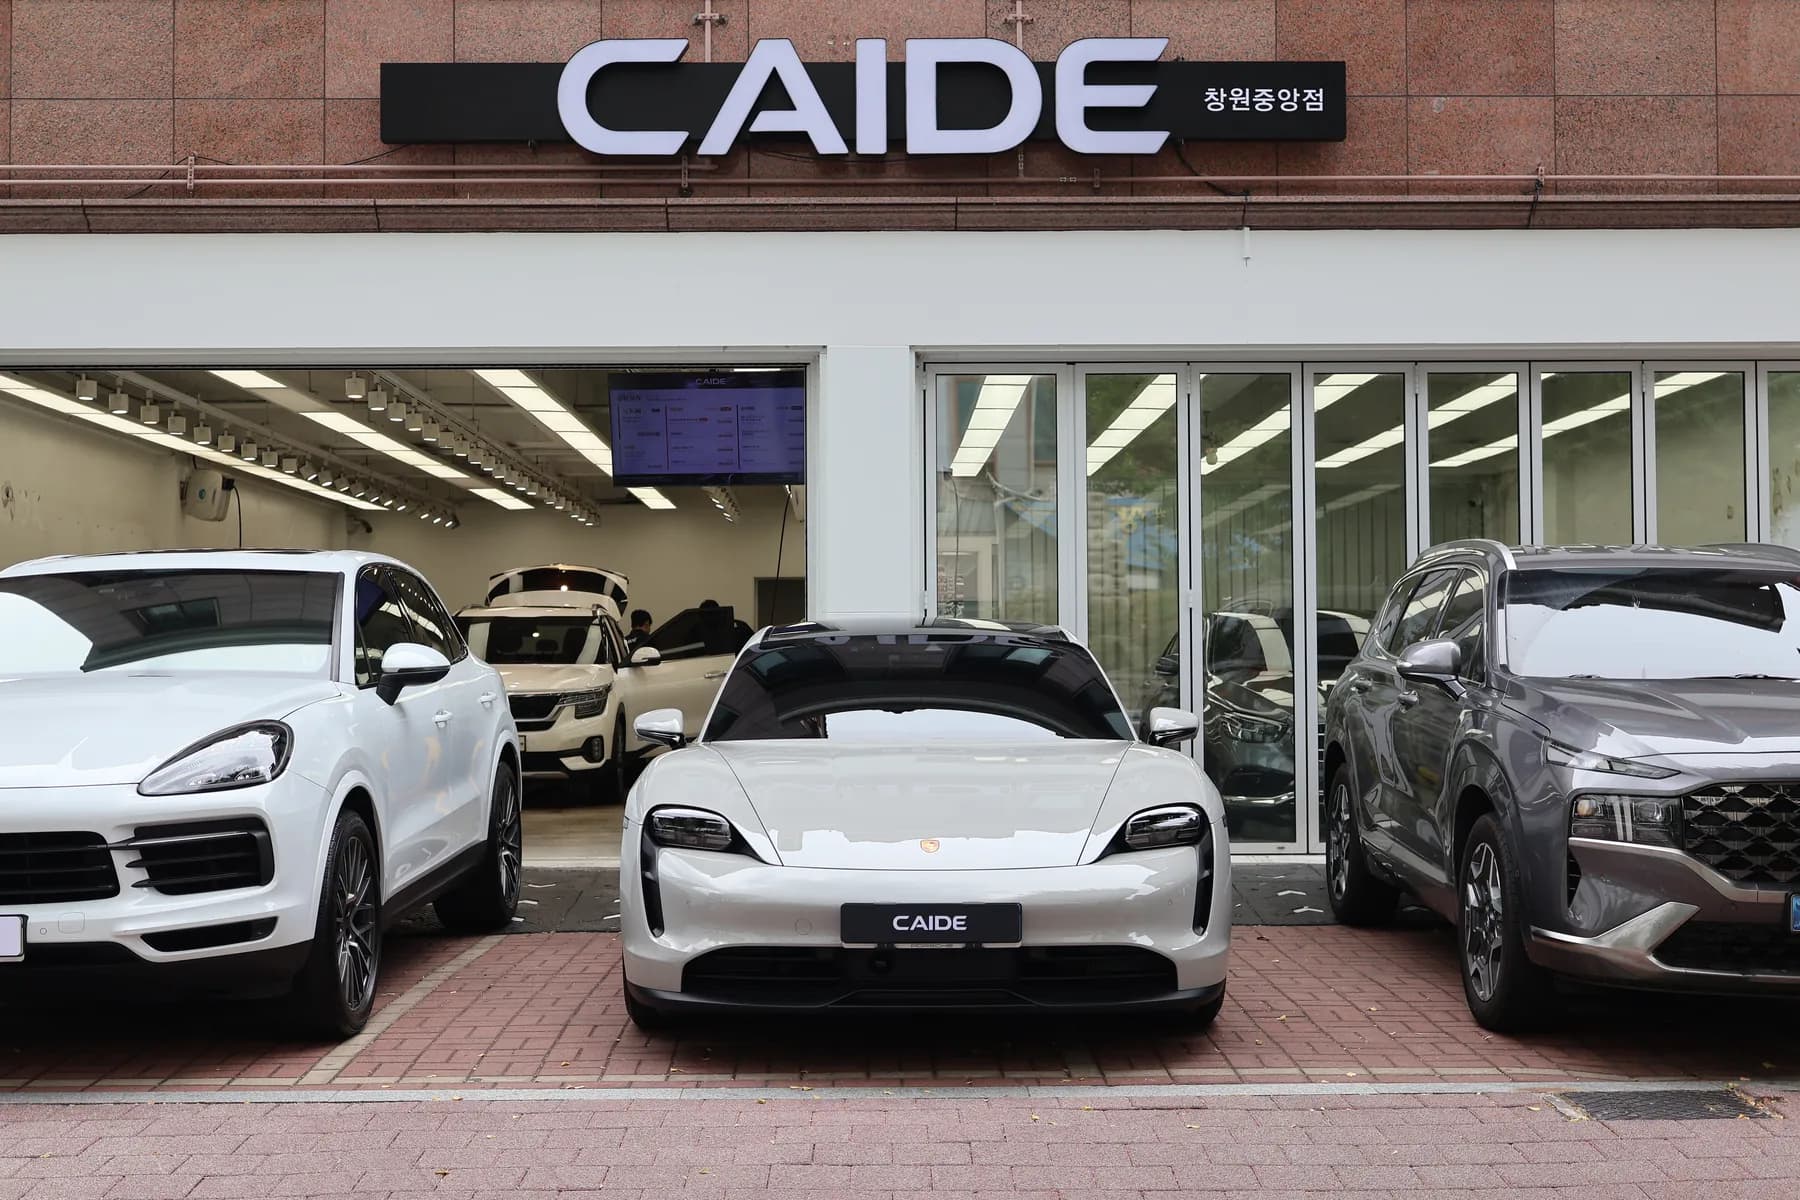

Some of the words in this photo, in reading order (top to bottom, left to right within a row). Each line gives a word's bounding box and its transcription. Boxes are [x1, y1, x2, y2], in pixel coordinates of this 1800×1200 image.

[557, 37, 1171, 155] CAIDE
[1204, 88, 1324, 112] 창원중앙점
[695, 377, 727, 385] CAIDE
[892, 915, 968, 931] CAIDE
